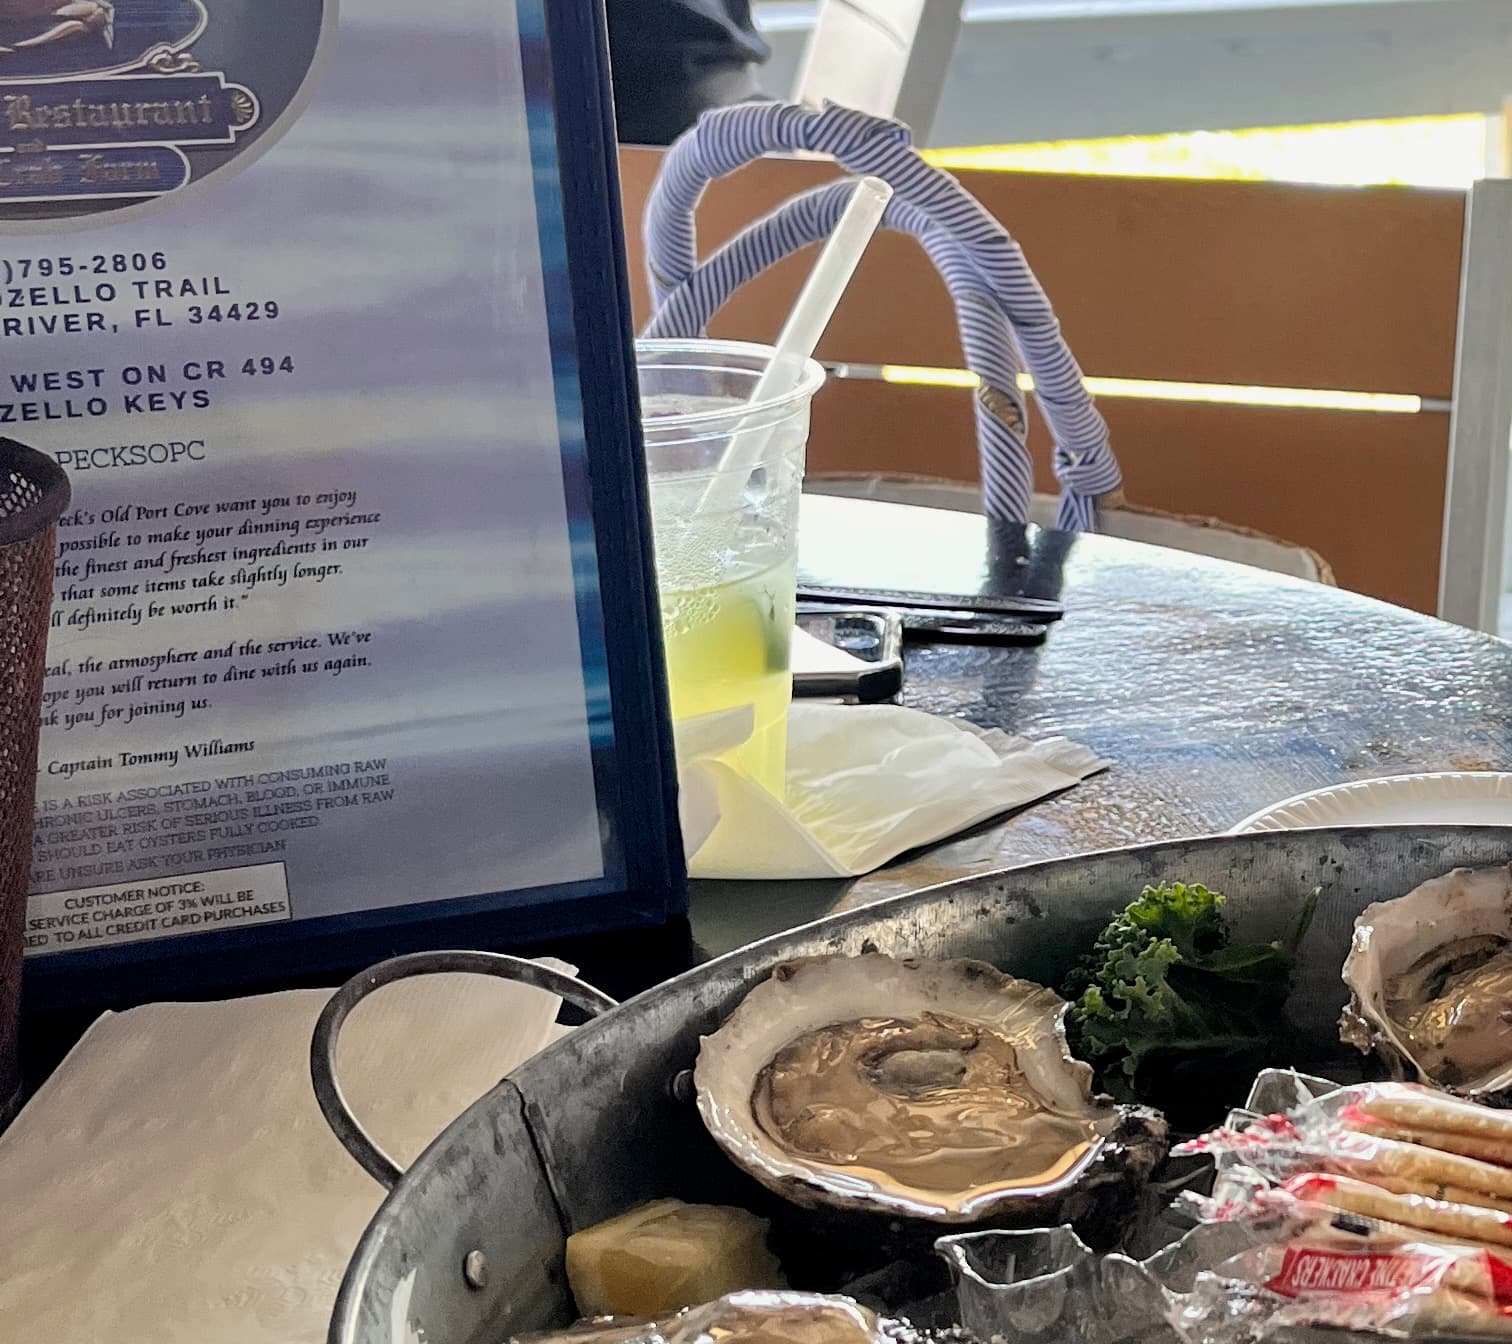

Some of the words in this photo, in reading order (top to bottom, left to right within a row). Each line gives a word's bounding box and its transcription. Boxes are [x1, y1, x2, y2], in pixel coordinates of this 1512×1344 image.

[3, 94, 213, 129] Restaurant
[0, 283, 117, 308] ZELLO
[132, 276, 230, 299] TRAIL
[3, 312, 118, 336] RIVER,
[135, 308, 173, 327] FL
[188, 301, 279, 325] 34429
[11, 369, 104, 393] WEST
[122, 364, 166, 385] ON
[183, 361, 226, 380] CR
[241, 356, 295, 376] 494
[0, 397, 108, 423] ZELLO
[124, 390, 210, 414] KEYS
[55, 440, 206, 470] PECKSOPC
[58, 510, 94, 528] eck's
[101, 506, 130, 524] Old
[136, 506, 168, 521] Port
[174, 503, 210, 517] Cove
[216, 499, 256, 514] want
[261, 496, 290, 516] you
[297, 494, 311, 506] to
[316, 489, 357, 509] enjoy
[55, 531, 121, 558] possible
[128, 533, 141, 546] to
[147, 527, 190, 543] make
[196, 524, 234, 544] your
[238, 518, 300, 537] dinning
[305, 512, 382, 534] experience
[55, 559, 79, 577] the
[78, 557, 127, 581] finest
[133, 551, 167, 571] and
[165, 548, 227, 573] freshest
[232, 540, 317, 565] ingredients
[322, 537, 338, 551] in
[343, 537, 369, 550] our
[61, 584, 94, 602] that
[100, 583, 139, 598] some
[144, 578, 186, 593] items
[192, 572, 225, 588] take
[230, 564, 289, 589] slightly
[51, 609, 63, 628] ll
[67, 603, 142, 631] definitely
[148, 600, 165, 617] be
[171, 595, 217, 614] worth
[44, 659, 71, 677] eal,
[78, 656, 102, 672] the
[108, 648, 198, 672] atmosphere
[202, 640, 236, 660] and
[239, 639, 263, 656] the
[267, 635, 322, 654] service.
[327, 630, 372, 647] We've
[42, 689, 70, 708] ope
[74, 684, 106, 704] you
[111, 675, 143, 695] will
[147, 674, 198, 691] return
[202, 672, 218, 685] to
[223, 665, 257, 683] dine
[261, 659, 297, 677] with
[301, 660, 319, 674] us
[323, 654, 373, 676] again.
[38, 710, 59, 728] nk
[64, 708, 95, 731] you
[94, 704, 123, 727] for
[124, 700, 185, 724] joining
[47, 755, 114, 780] Captain
[119, 749, 179, 768] Tommy
[184, 739, 255, 759] Williams
[32, 812, 95, 829] HRONIC
[303, 781, 323, 795] OR
[328, 773, 390, 792] IMMUNE
[43, 800, 57, 812] IS
[62, 796, 76, 810] A
[78, 792, 113, 809] RISK
[116, 781, 211, 803] ASSOCIATED
[215, 774, 253, 789] WITH
[257, 763, 350, 784] CONSUMING
[354, 758, 386, 774] RAW
[33, 834, 43, 847] A
[48, 825, 118, 845] GREATER
[123, 820, 157, 834] RISK
[161, 817, 182, 830] OF
[185, 808, 249, 827] SERIOUS
[253, 800, 314, 819] ILLNESS
[316, 793, 359, 809] FROM
[363, 788, 394, 803] RAW
[38, 844, 102, 862] SHOULD
[107, 838, 135, 853] EAT
[140, 830, 206, 850] OYSTERS
[210, 824, 254, 839] FULLY
[127, 856, 158, 870] ASK
[163, 850, 203, 866] YOUR
[29, 913, 89, 930] SERVICE
[93, 903, 153, 921] CHARGE
[156, 900, 175, 914] OF
[178, 897, 198, 910] 3%
[201, 892, 234, 908] WILL
[238, 889, 254, 902] BE
[65, 888, 144, 909] CUSTOMER
[148, 881, 205, 900] NOTICE:
[55, 930, 73, 944] TO
[78, 924, 103, 941] ALL
[106, 918, 158, 936] CREDIT
[161, 912, 201, 928] CARD
[204, 901, 286, 923] PURCHASES
[1291, 1254, 1368, 1288] CRACKERS
